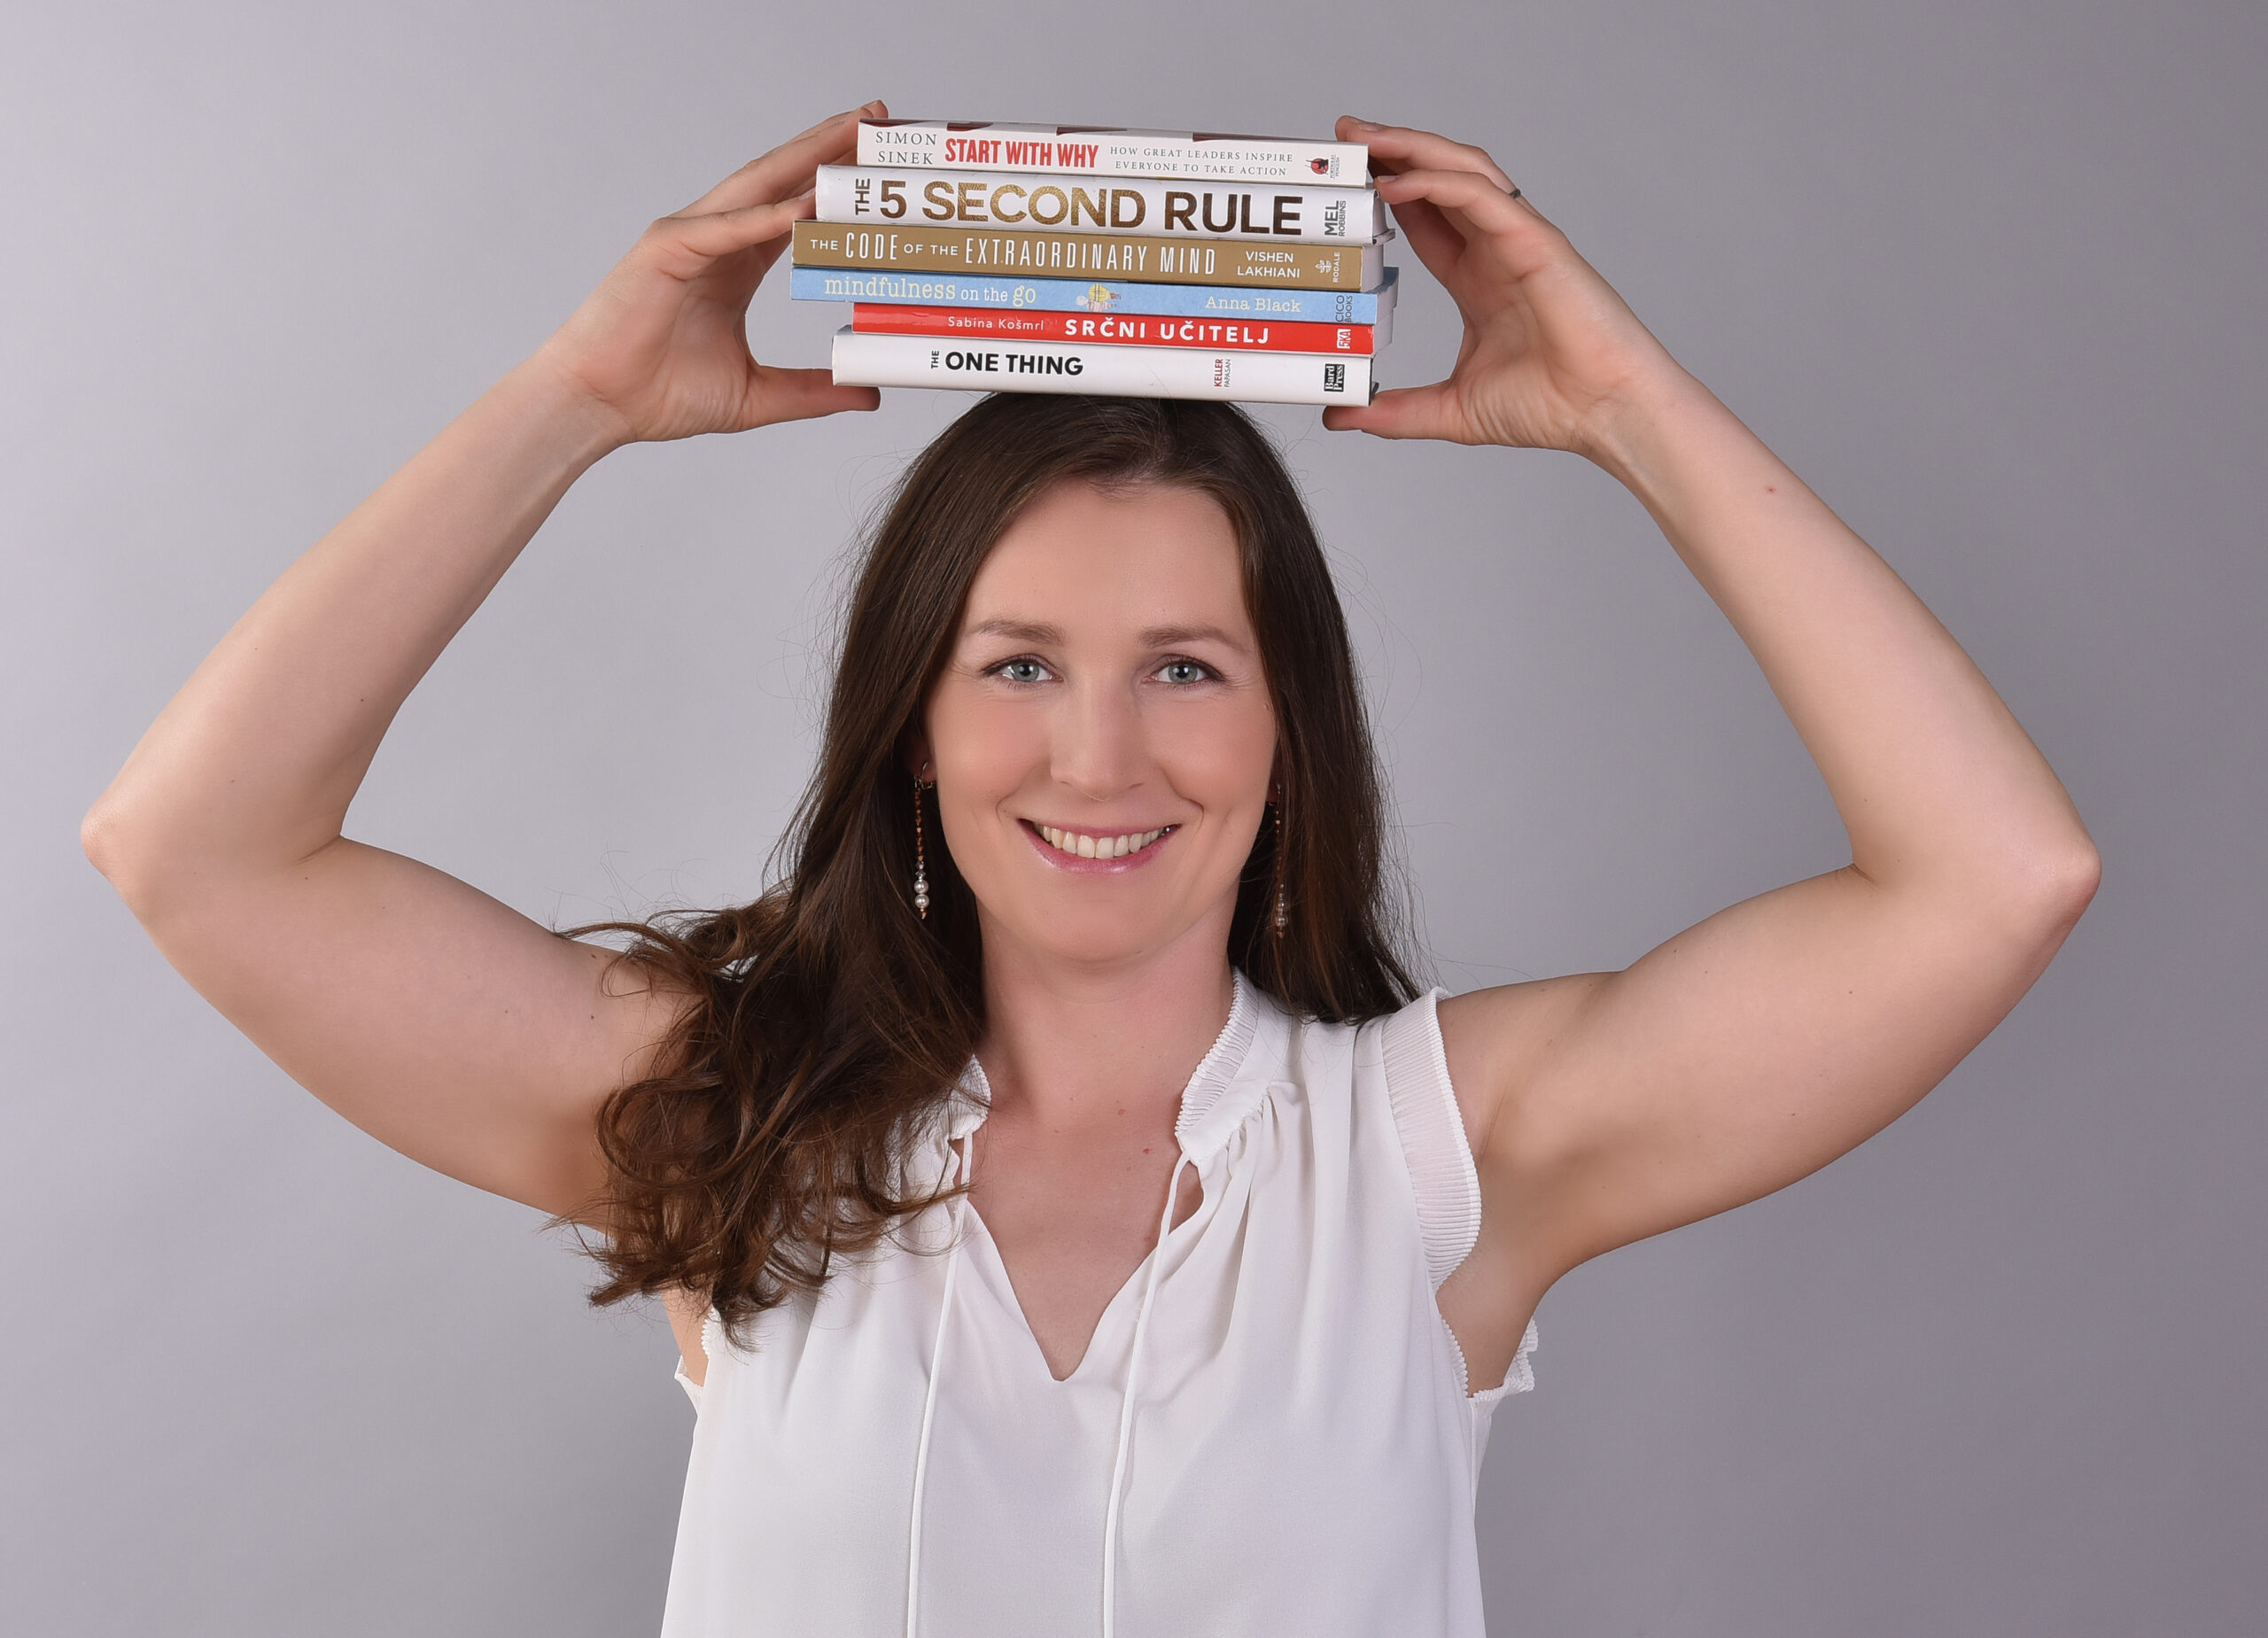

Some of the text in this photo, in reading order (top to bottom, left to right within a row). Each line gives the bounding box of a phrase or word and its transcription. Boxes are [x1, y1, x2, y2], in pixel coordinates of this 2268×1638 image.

[875, 131, 936, 145] SIMON
[877, 151, 934, 165] SINEK
[944, 138, 1099, 167] START WITH WHY
[1110, 146, 1293, 162] HOW GREAT LEADERS INSPIRE
[1115, 160, 1286, 176] EVERYONE TO TAKE ACTION
[855, 178, 1303, 235] THE 5 SECOND RULE
[1324, 200, 1339, 236] MEL
[811, 232, 1216, 275] THE CODE OF THE EXTRAORDINARY MIND
[1246, 251, 1293, 263] VISHEN
[1238, 266, 1301, 278] LAKHIANI
[825, 276, 1037, 307] mindfulness on the go
[1205, 296, 1301, 313] Anna Black
[1335, 295, 1345, 322] CICO
[948, 315, 1045, 330] Sabina Košmrl
[1065, 316, 1269, 344] SRČNI UČITELJ
[930, 350, 1084, 376] THE ONE THING
[1214, 358, 1223, 387] KELLER
[1325, 365, 1335, 390] Bard
[1333, 365, 1344, 391] Press
